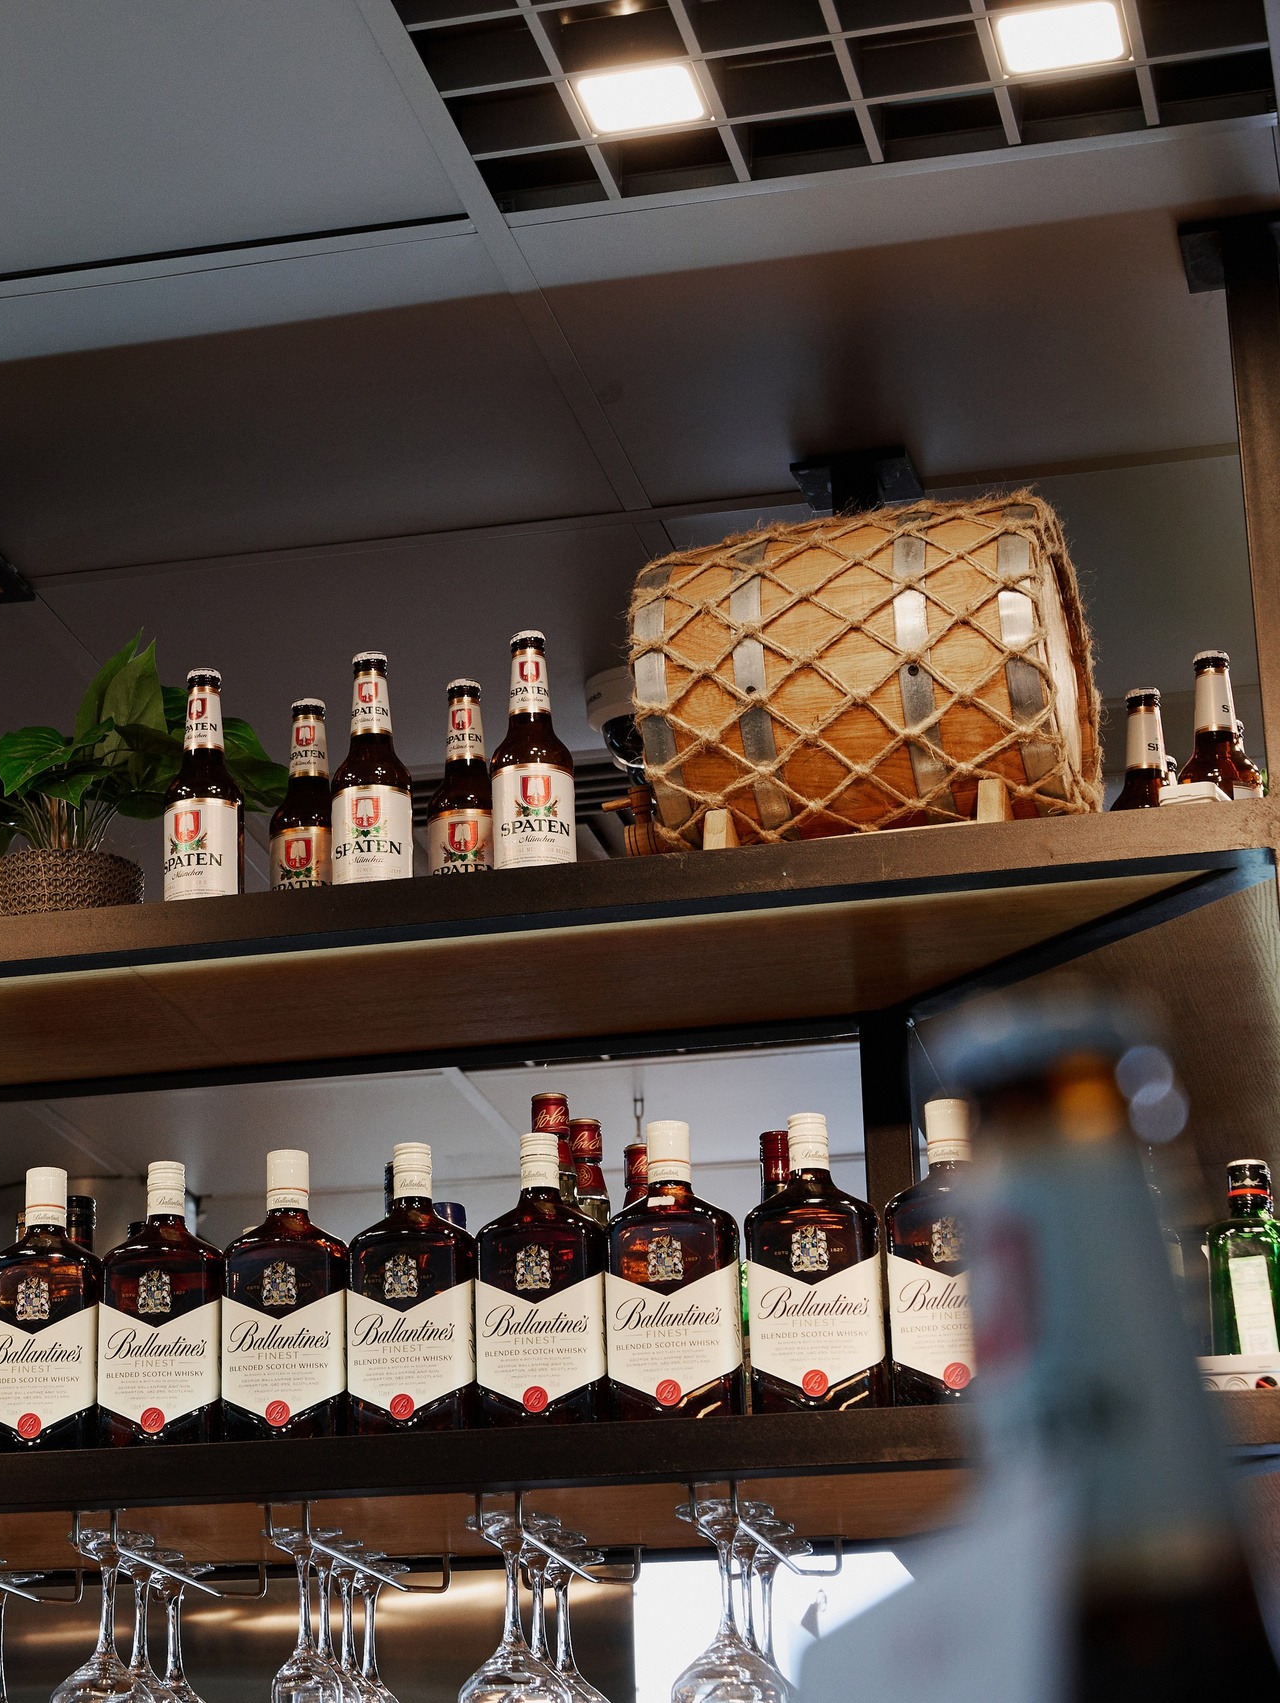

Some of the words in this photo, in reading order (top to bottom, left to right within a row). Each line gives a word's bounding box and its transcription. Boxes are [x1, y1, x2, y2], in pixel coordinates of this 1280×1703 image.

[501, 818, 570, 838] SPATEN
[518, 833, 556, 844] München
[335, 839, 402, 860] SPATEN
[164, 852, 223, 876] SPATEN
[171, 868, 204, 881] München
[758, 1286, 869, 1320] Ballantine's
[613, 1297, 722, 1331] Ballantine's
[932, 1312, 969, 1320] FINES
[482, 1304, 589, 1338] Ballantine's
[792, 1318, 837, 1328] FINEST
[352, 1313, 455, 1347] Ballantine's
[646, 1329, 689, 1338] FINEST
[900, 1325, 938, 1333] BLENDED
[227, 1320, 331, 1353] Ballantine's
[514, 1336, 557, 1345] FINEST
[761, 1332, 798, 1340] BLENDED
[104, 1327, 207, 1360] Ballantine's
[382, 1344, 423, 1353] FINEST
[616, 1343, 652, 1351] BLENDED
[257, 1351, 300, 1360] FINEST
[135, 1359, 176, 1368] FINEST
[11, 1365, 51, 1373] FINEST
[106, 1371, 140, 1379] BLENDED
